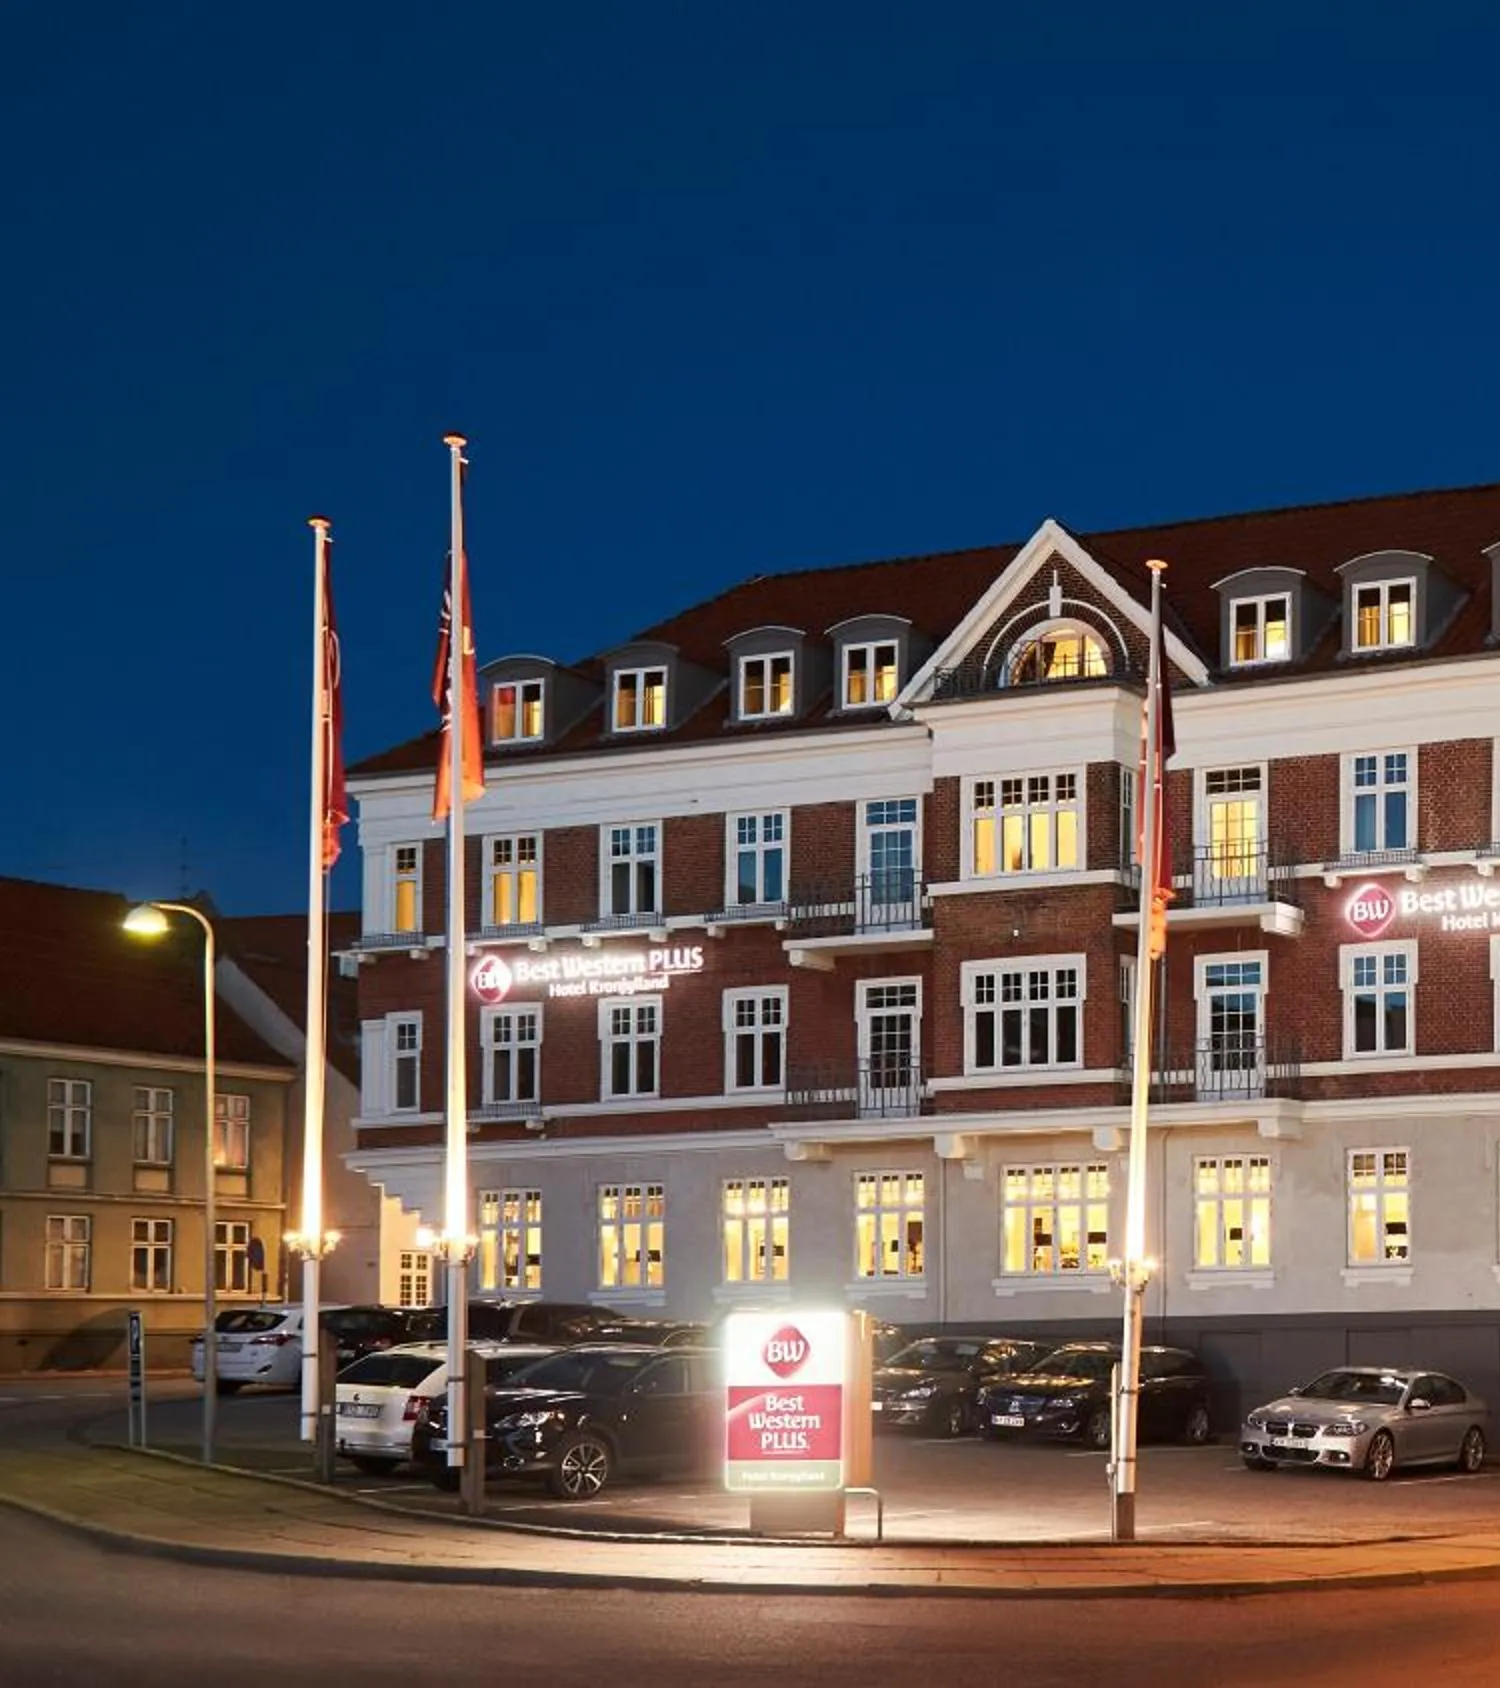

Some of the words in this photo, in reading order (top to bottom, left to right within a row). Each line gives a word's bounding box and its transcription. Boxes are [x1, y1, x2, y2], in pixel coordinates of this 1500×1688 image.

[1352, 898, 1390, 923] BW
[1400, 887, 1459, 914] Best
[1441, 912, 1488, 931] Hotel
[515, 957, 560, 983] Best
[561, 952, 645, 979] Western
[650, 946, 704, 971] PLUS
[549, 979, 587, 997] Hotel
[767, 1339, 805, 1363] BW
[765, 1395, 805, 1411] Best
[749, 1413, 820, 1430] Western
